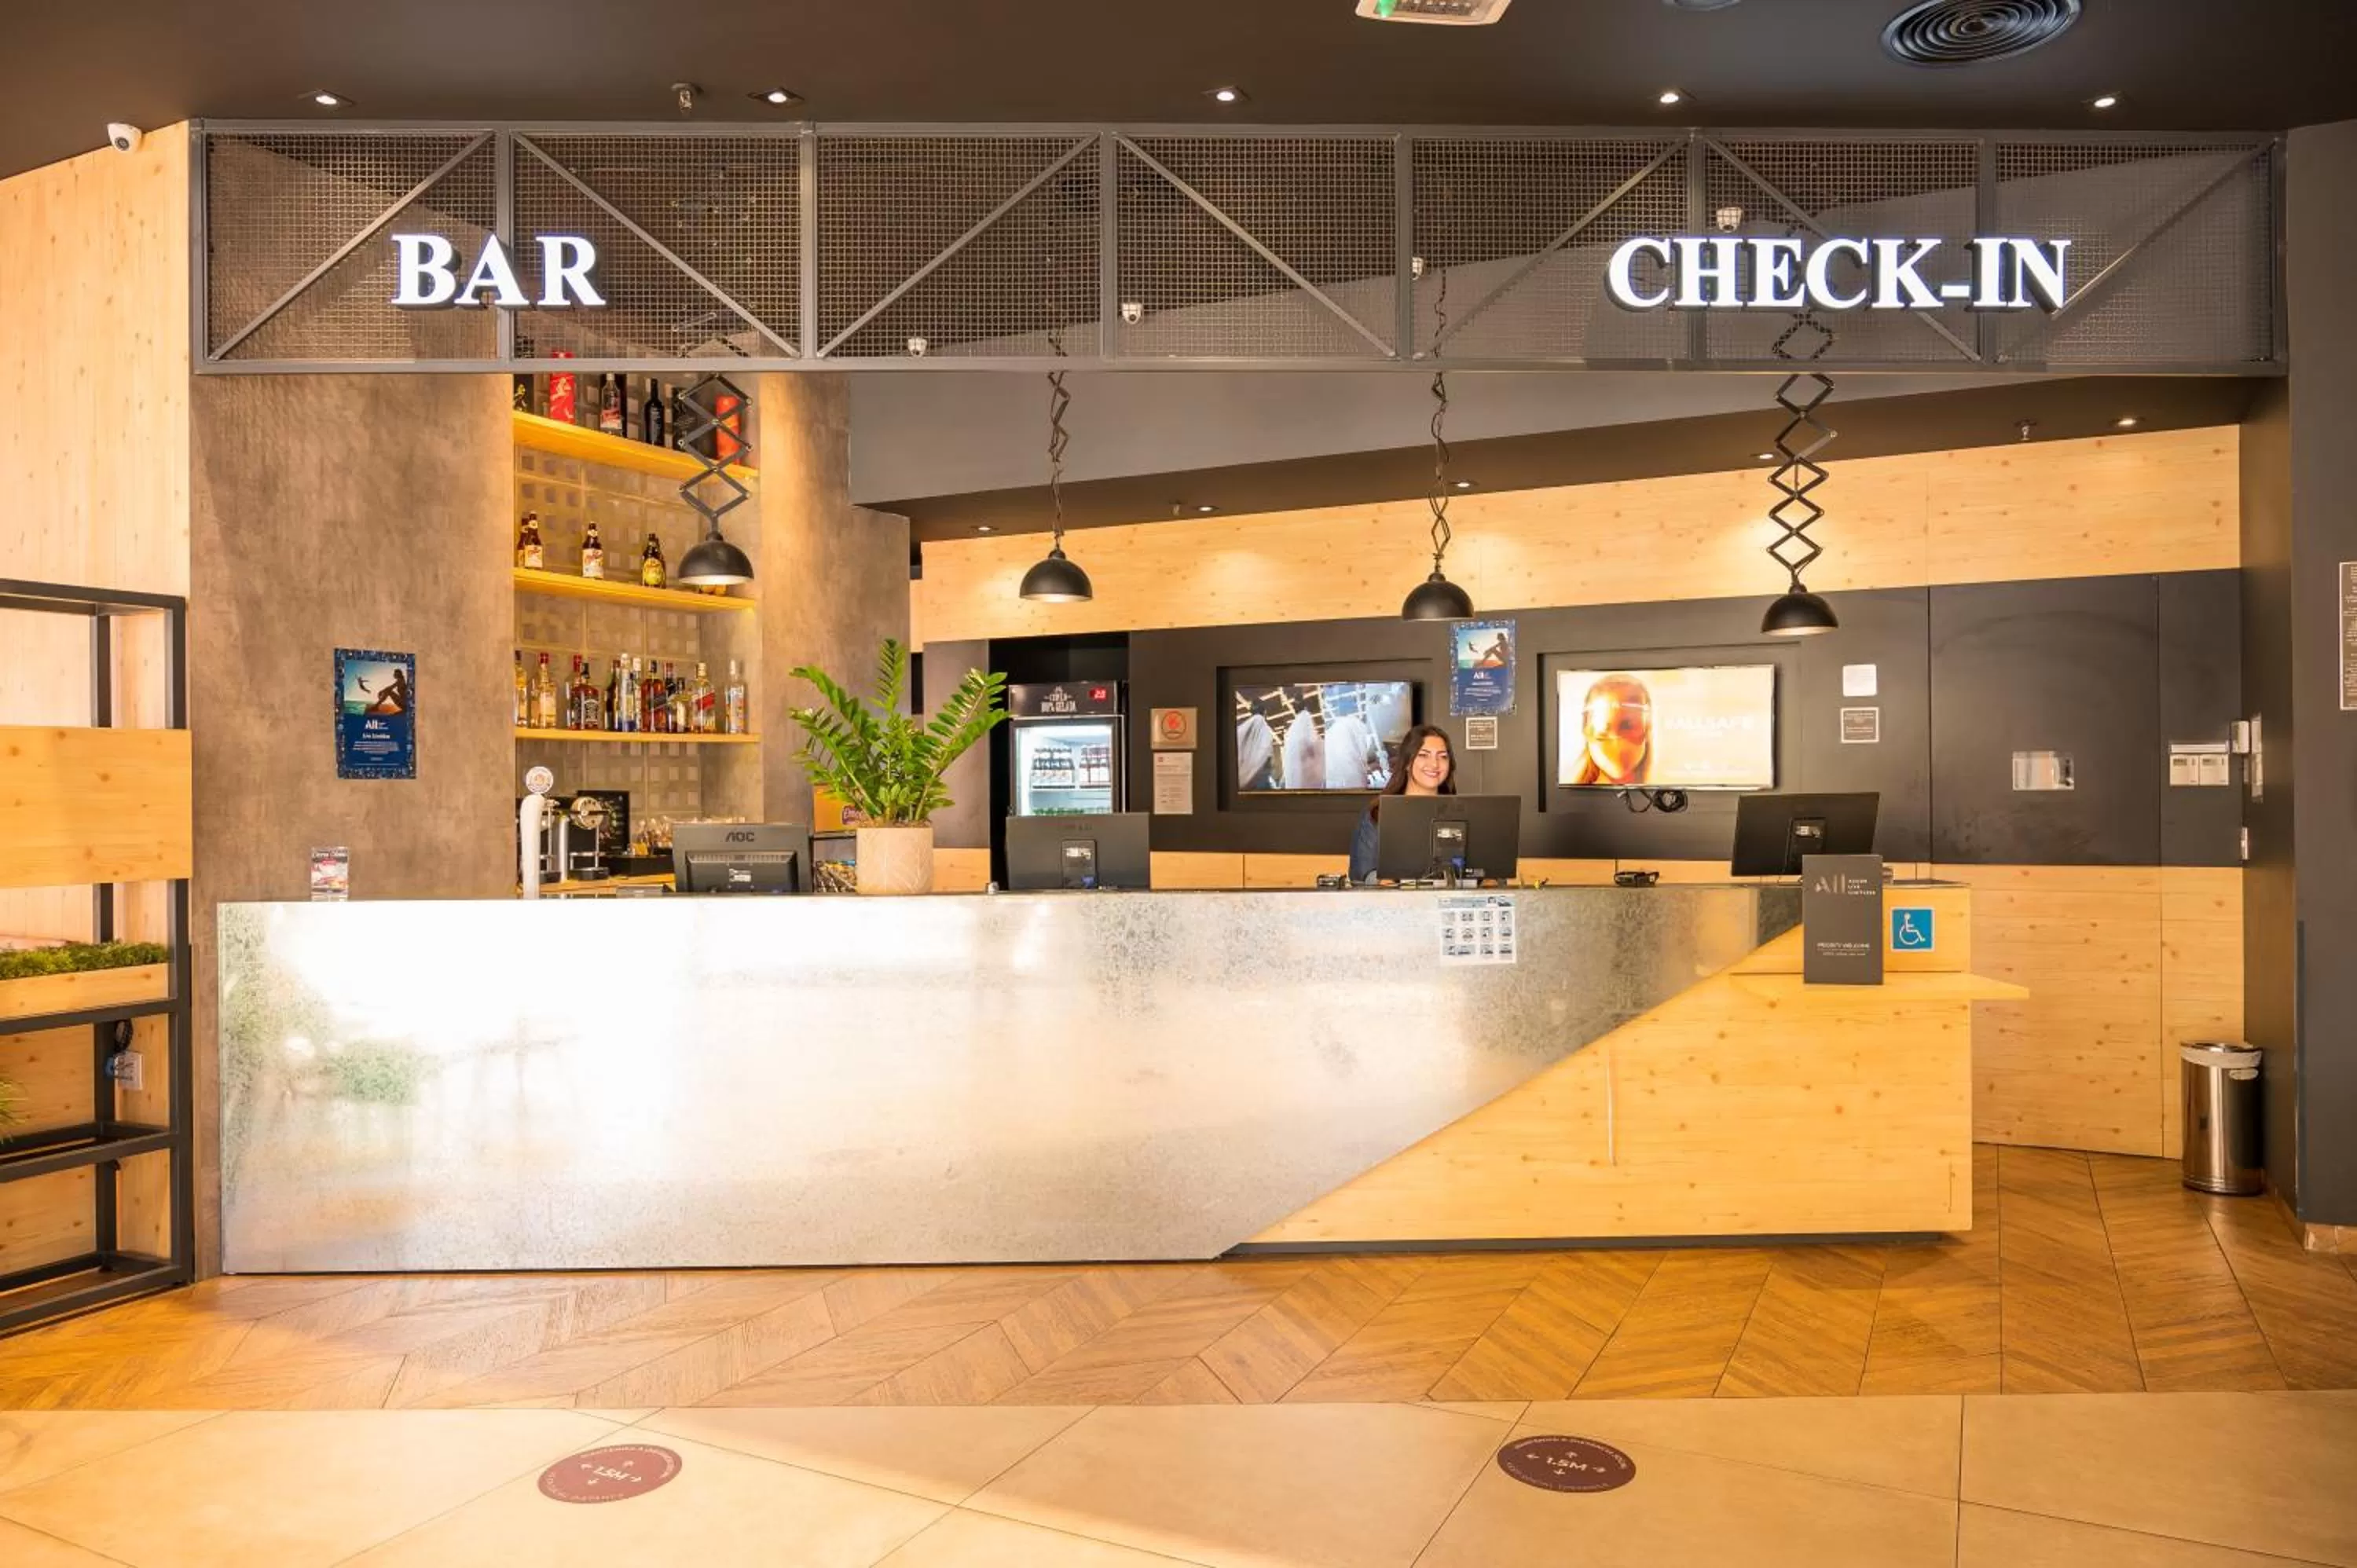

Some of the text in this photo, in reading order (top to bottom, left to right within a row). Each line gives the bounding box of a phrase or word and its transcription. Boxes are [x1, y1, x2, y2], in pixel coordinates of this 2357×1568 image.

[390, 234, 607, 306] BAR
[1607, 237, 2072, 310] CHECK-IN
[725, 832, 755, 842] AOC
